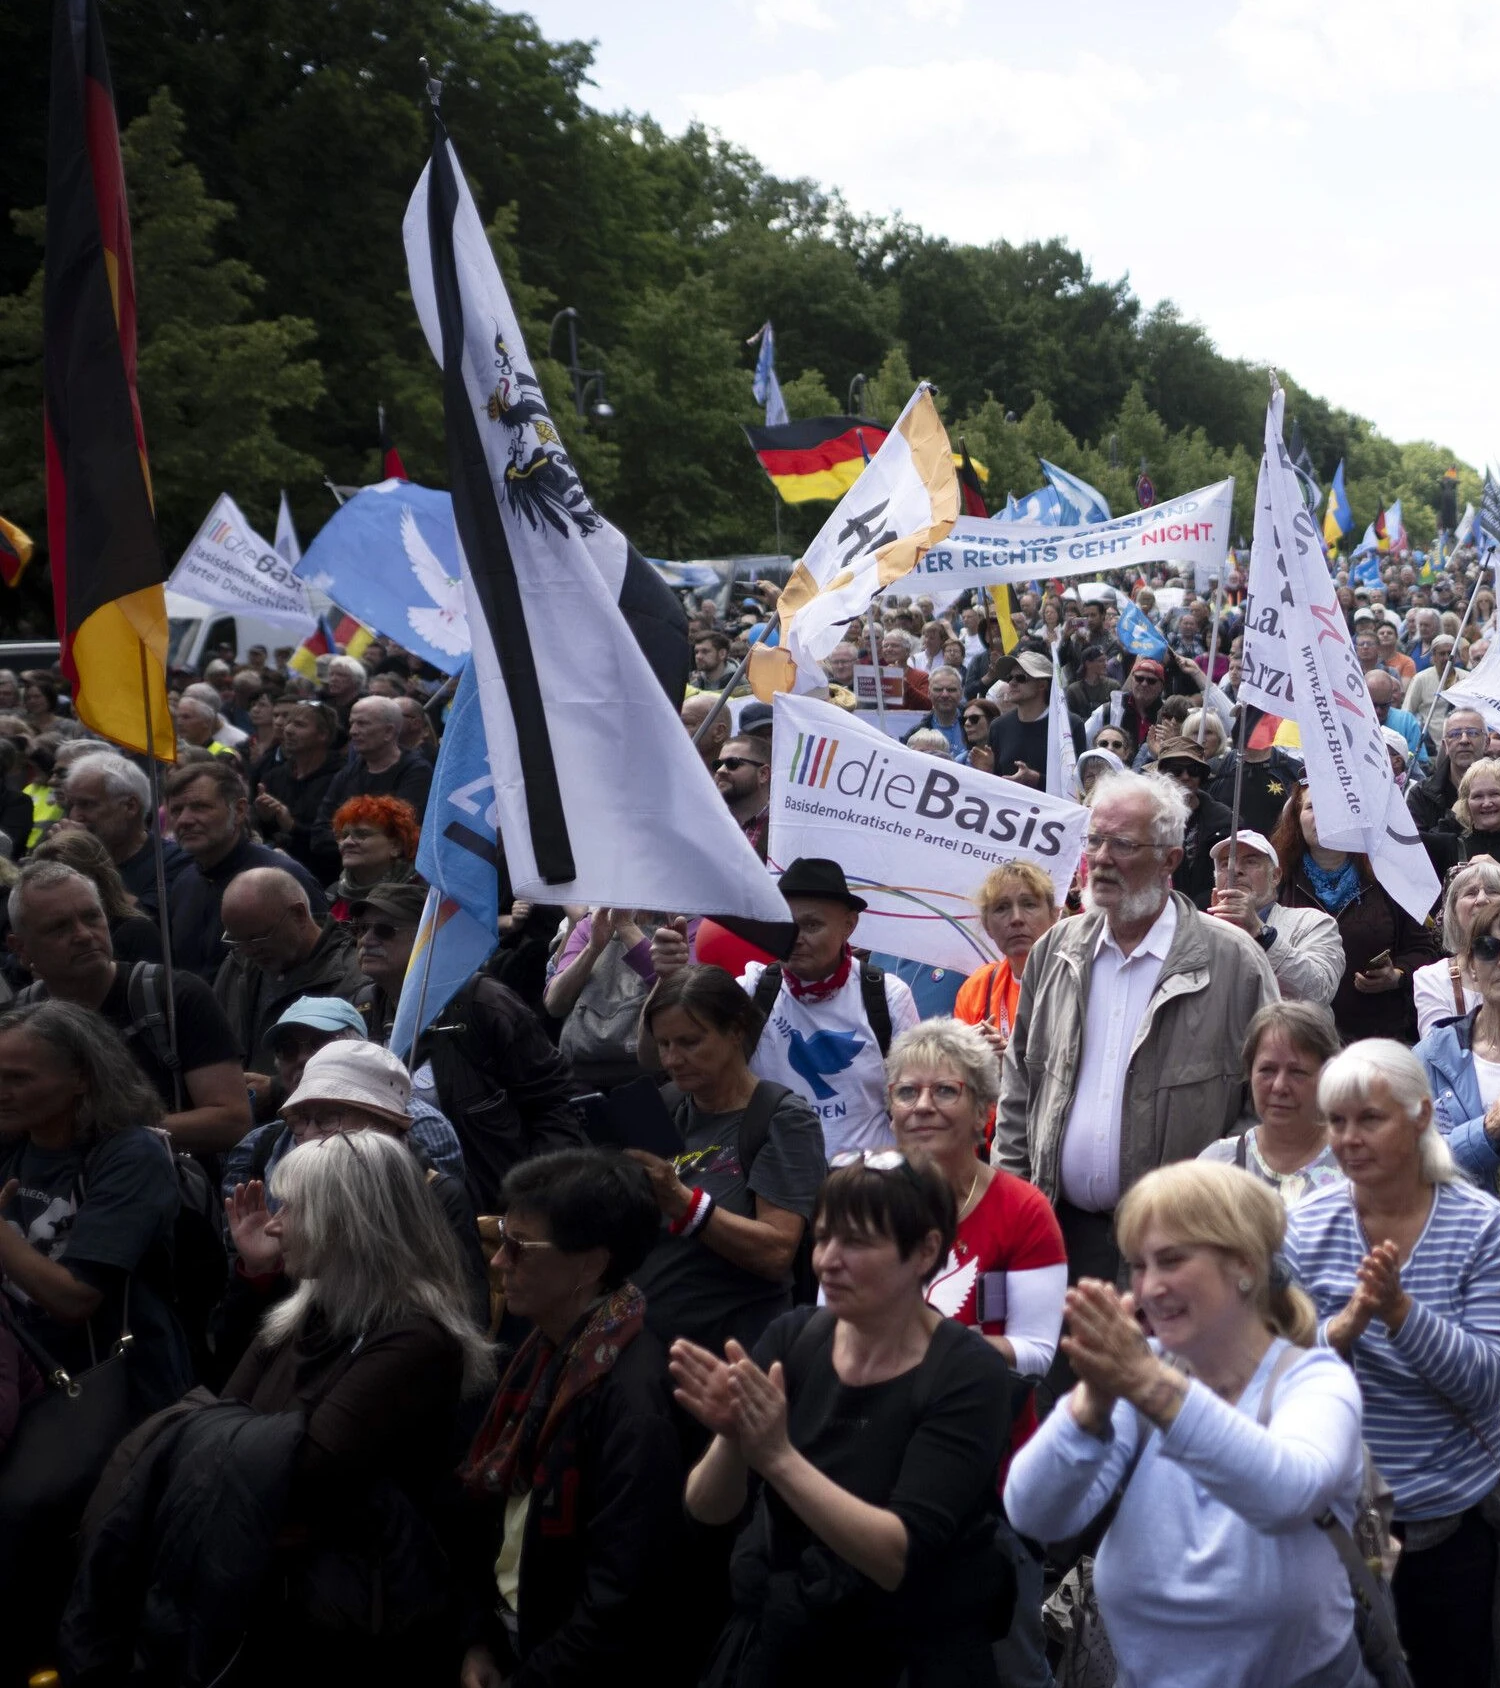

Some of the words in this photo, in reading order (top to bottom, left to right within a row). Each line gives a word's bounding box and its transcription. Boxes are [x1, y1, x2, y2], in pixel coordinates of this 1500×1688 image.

[962, 545, 1059, 570] RECHTS
[1067, 535, 1132, 560] GEHT
[1141, 522, 1216, 546] NICHT.
[1300, 645, 1361, 815] www.RKI-Buch.de
[784, 795, 912, 838] Basisdemokratische
[914, 827, 959, 851] Partei
[836, 749, 1066, 856] dieBasis
